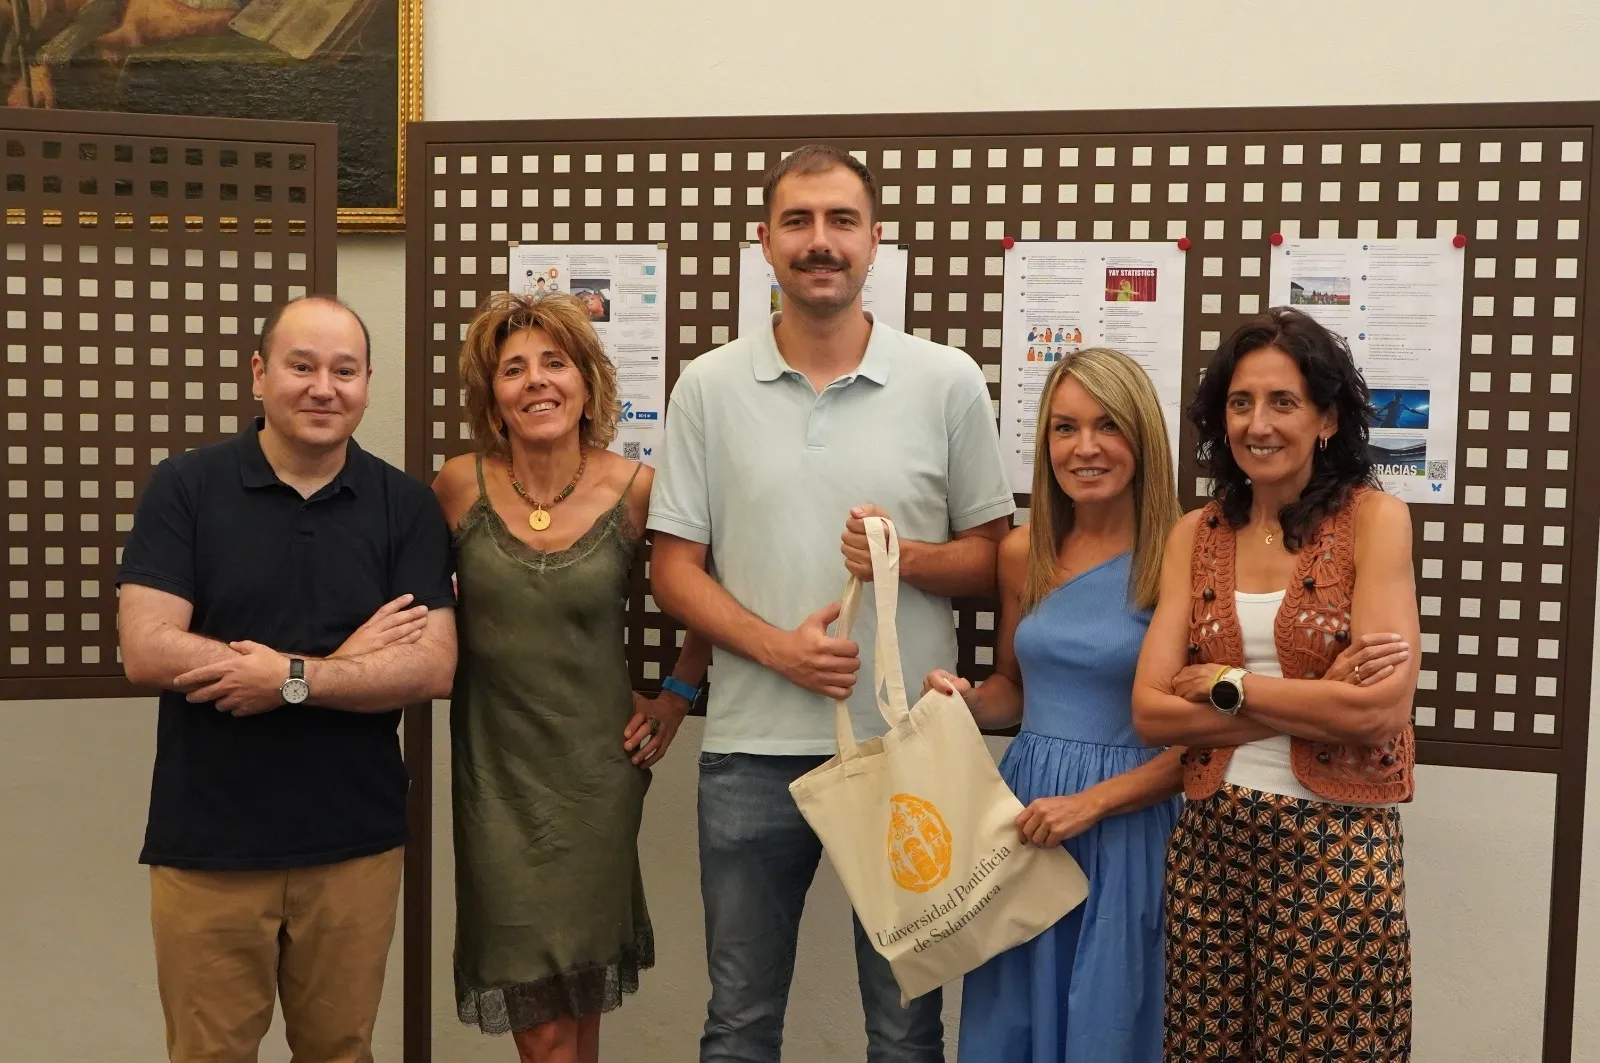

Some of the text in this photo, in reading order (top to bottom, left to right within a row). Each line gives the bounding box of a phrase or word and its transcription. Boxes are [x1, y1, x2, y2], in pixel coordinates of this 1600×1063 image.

[1108, 269, 1155, 277] YAY STATISTICS
[875, 844, 1012, 949] Universidad Pontificia
[913, 883, 1002, 954] de Salamanca
